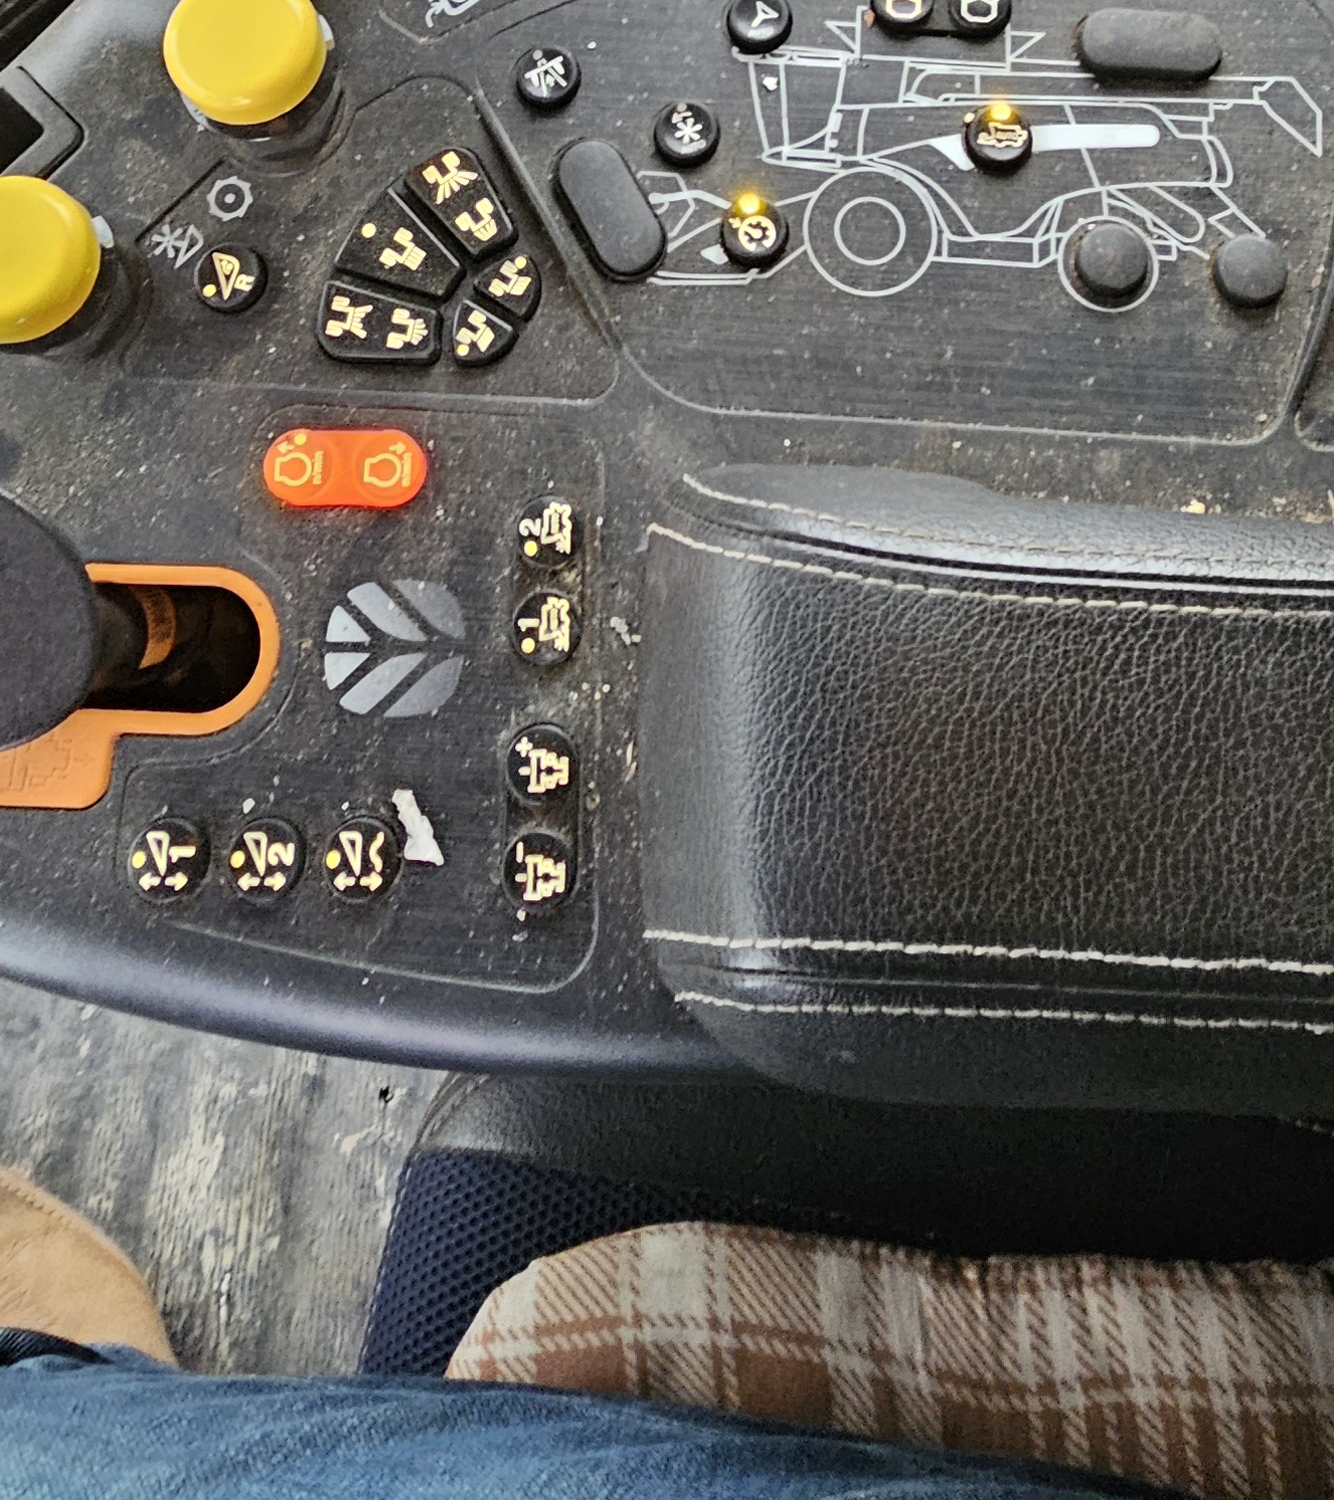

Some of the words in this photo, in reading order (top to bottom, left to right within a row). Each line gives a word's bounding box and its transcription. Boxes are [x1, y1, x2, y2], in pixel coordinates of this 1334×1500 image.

[234, 273, 255, 292] R
[519, 518, 541, 537] 2
[518, 618, 540, 632] 1
[169, 846, 196, 863] 1
[267, 842, 295, 866] 2
